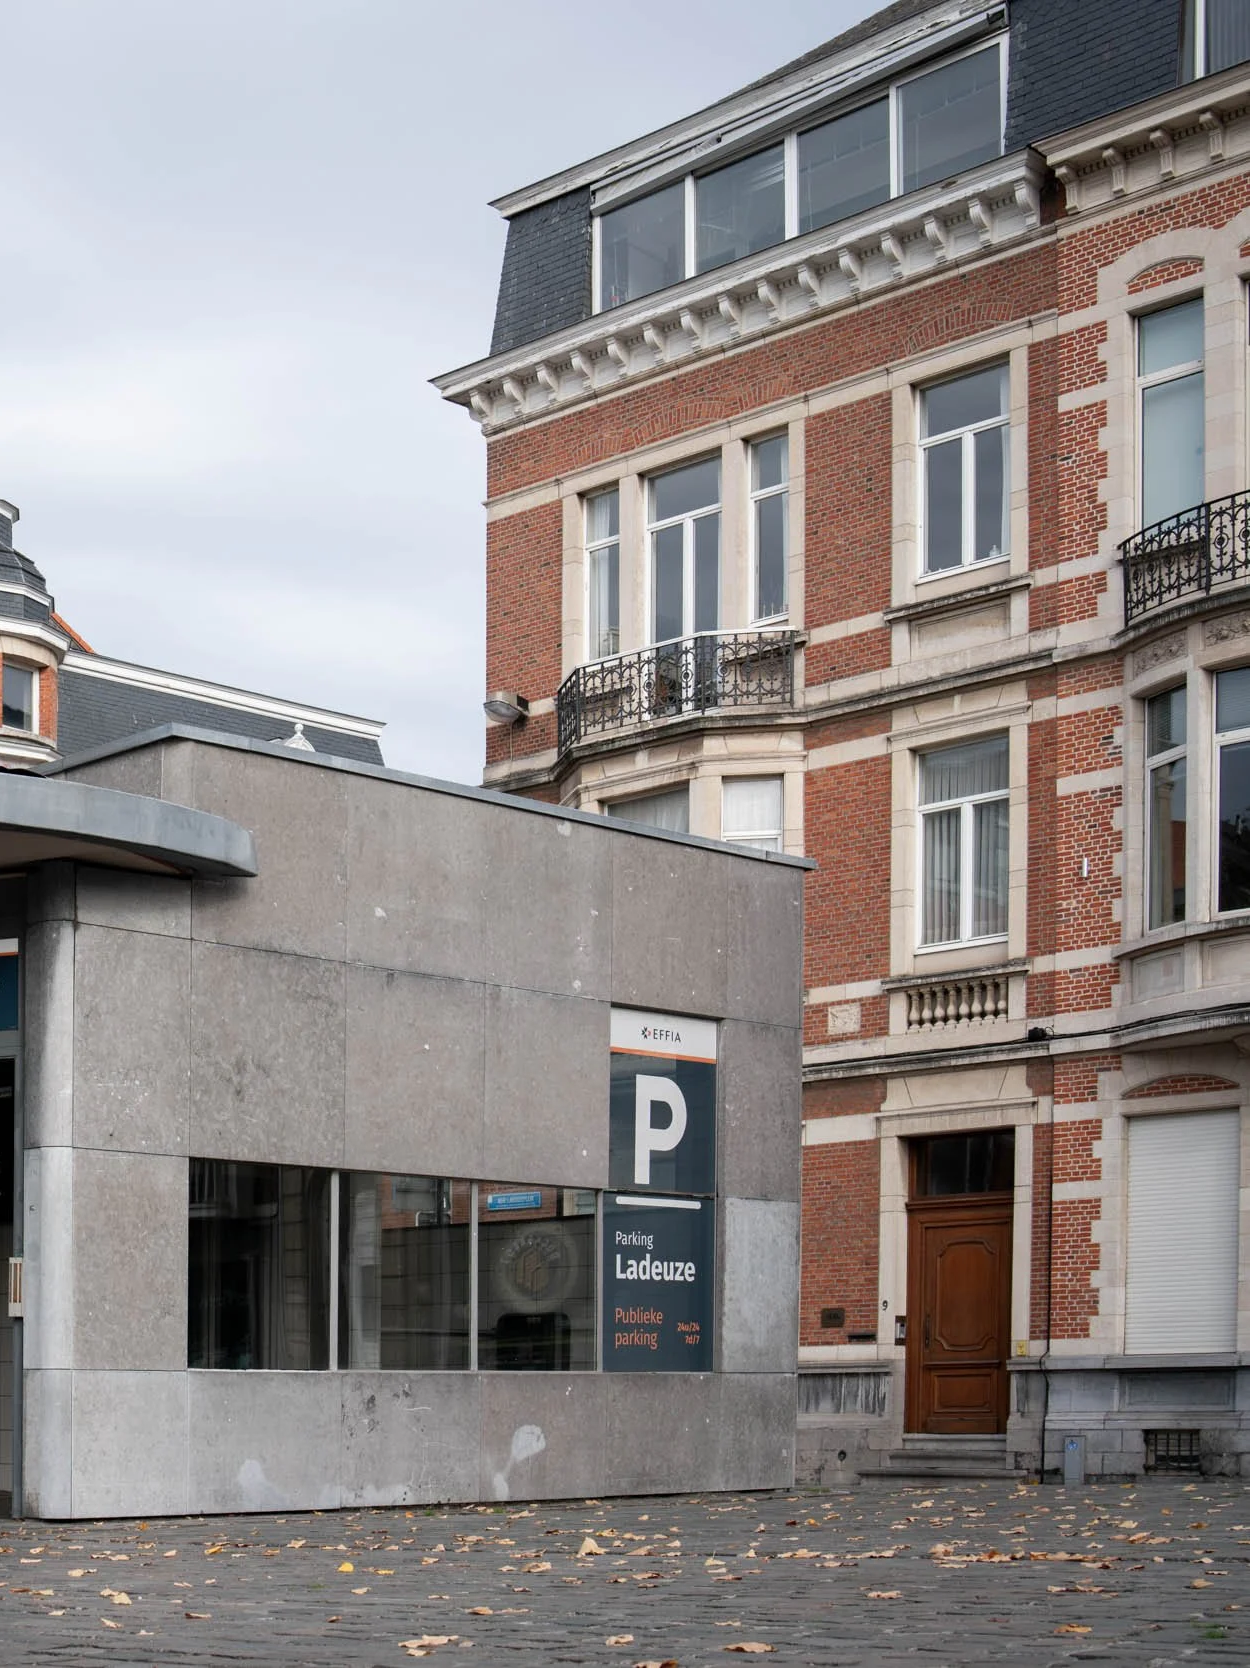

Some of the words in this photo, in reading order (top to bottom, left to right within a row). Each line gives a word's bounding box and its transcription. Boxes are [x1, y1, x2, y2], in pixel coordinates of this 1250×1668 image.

[653, 1028, 682, 1043] EFFIA
[634, 1073, 688, 1184] P
[615, 1231, 654, 1250] Parking
[615, 1253, 696, 1282] Ladeuze
[615, 1306, 663, 1324] Publieke
[882, 1300, 888, 1311] 9
[615, 1328, 658, 1350] parking
